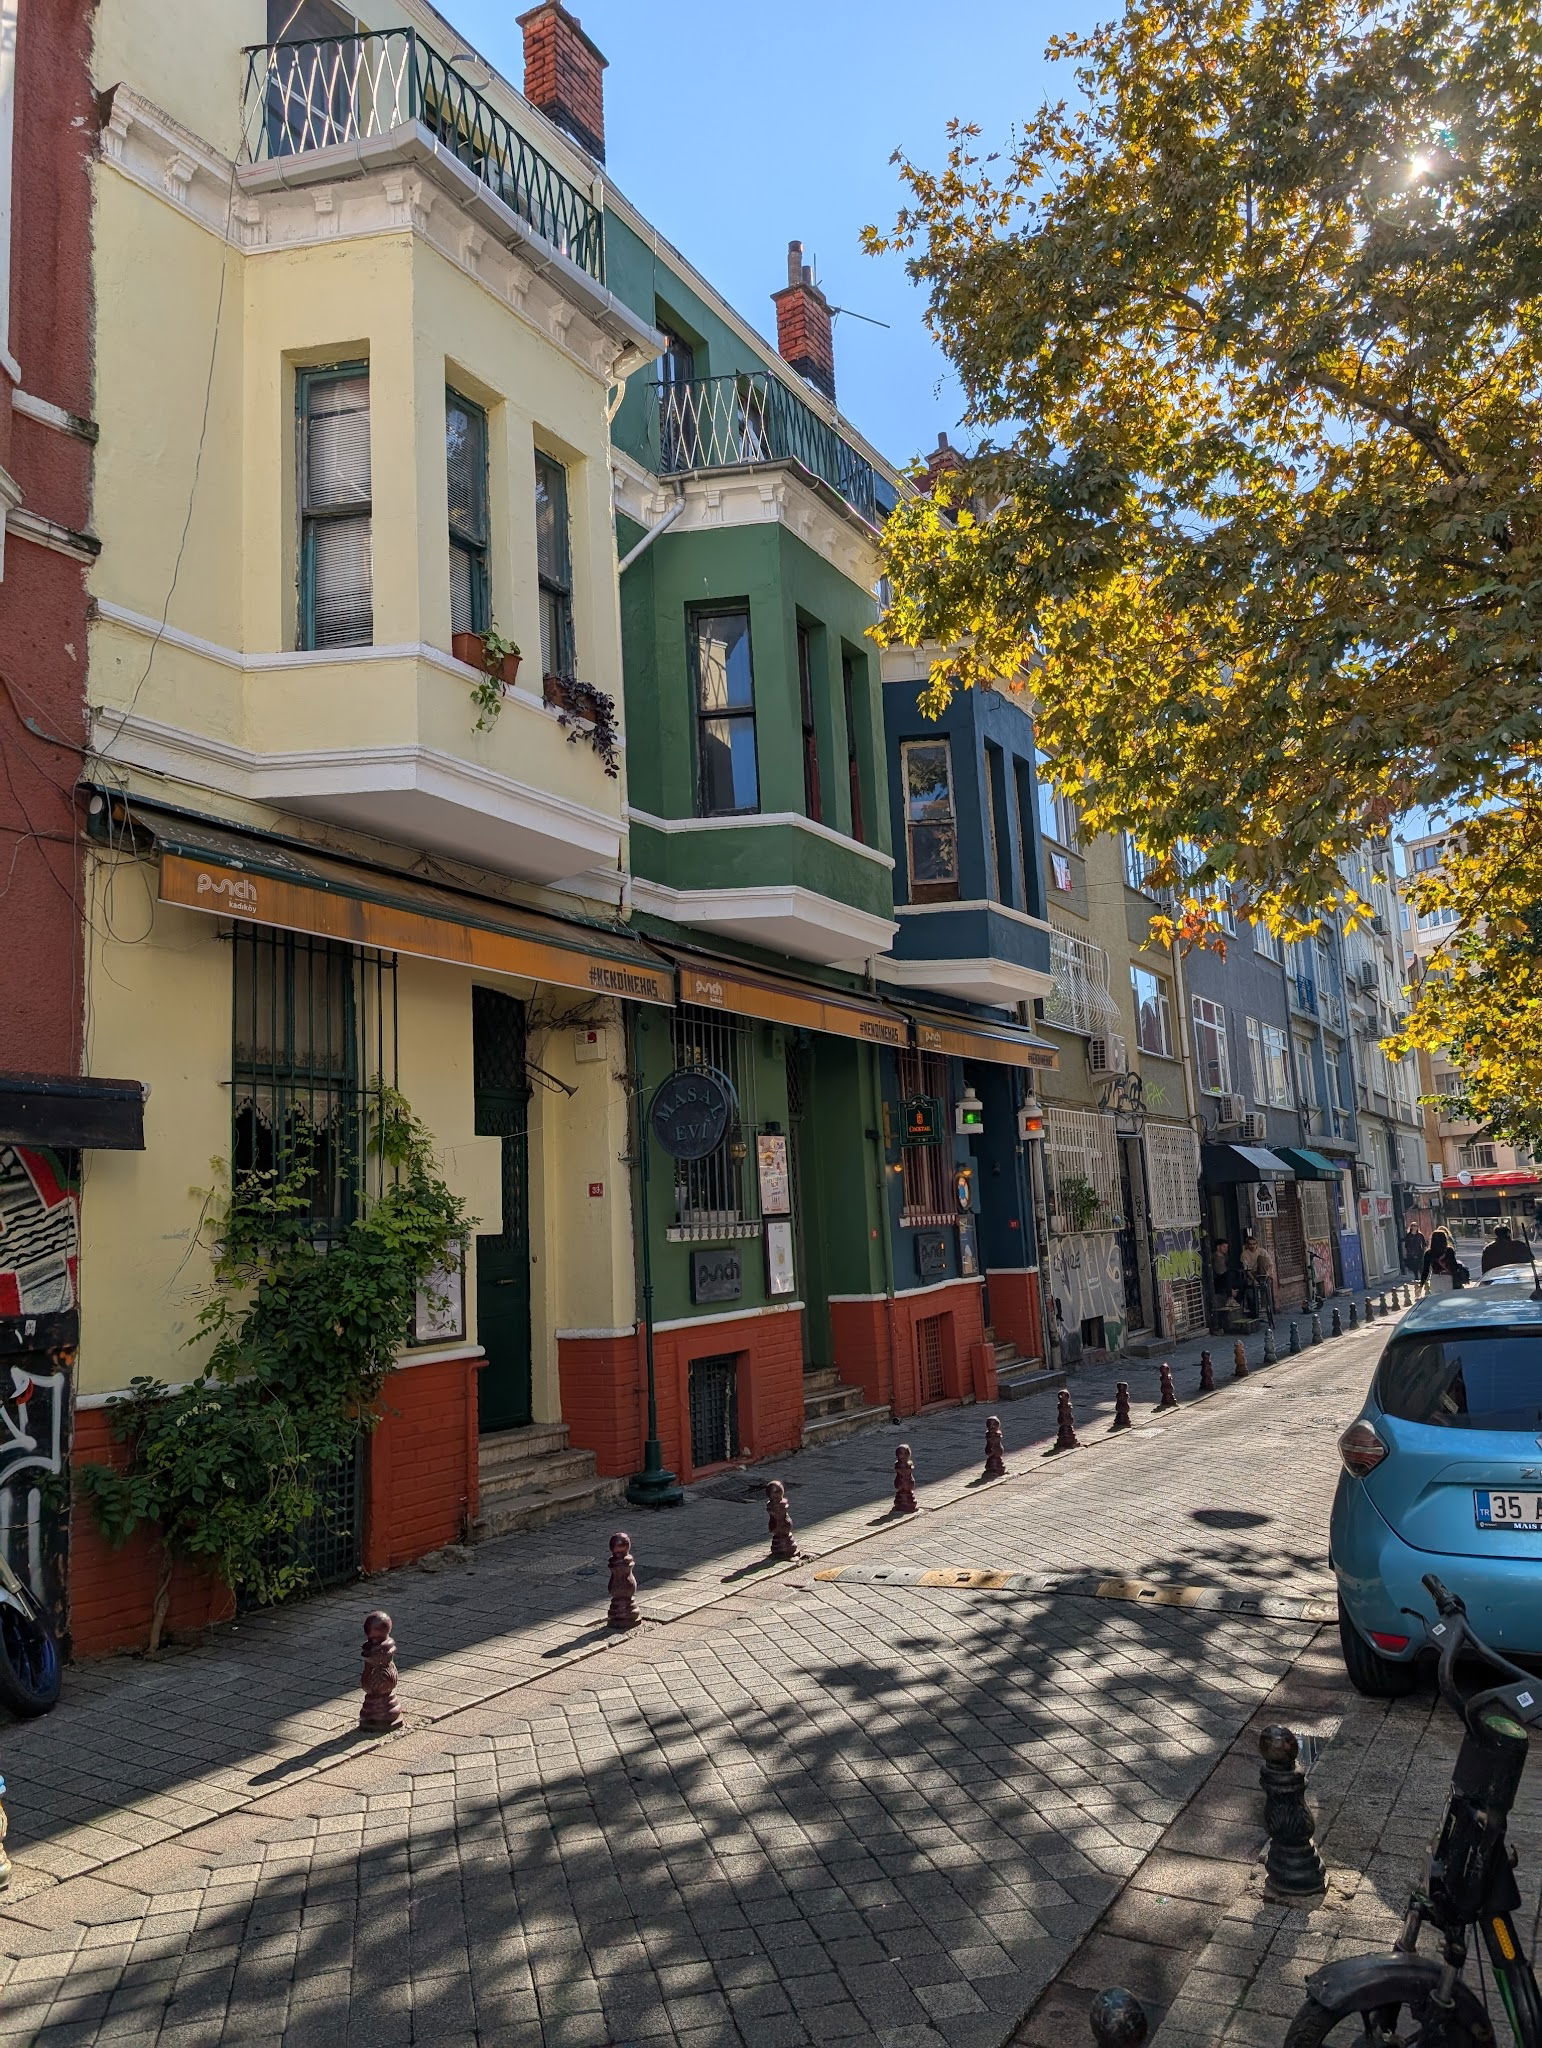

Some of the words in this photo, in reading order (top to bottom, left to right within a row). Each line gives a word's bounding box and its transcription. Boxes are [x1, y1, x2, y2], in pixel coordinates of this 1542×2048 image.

[197, 873, 257, 901] punch
[695, 980, 723, 996] punch
[656, 1087, 723, 1121] MASAL
[1480, 1508, 1490, 1516] TR
[1493, 1496, 1522, 1519] 35
